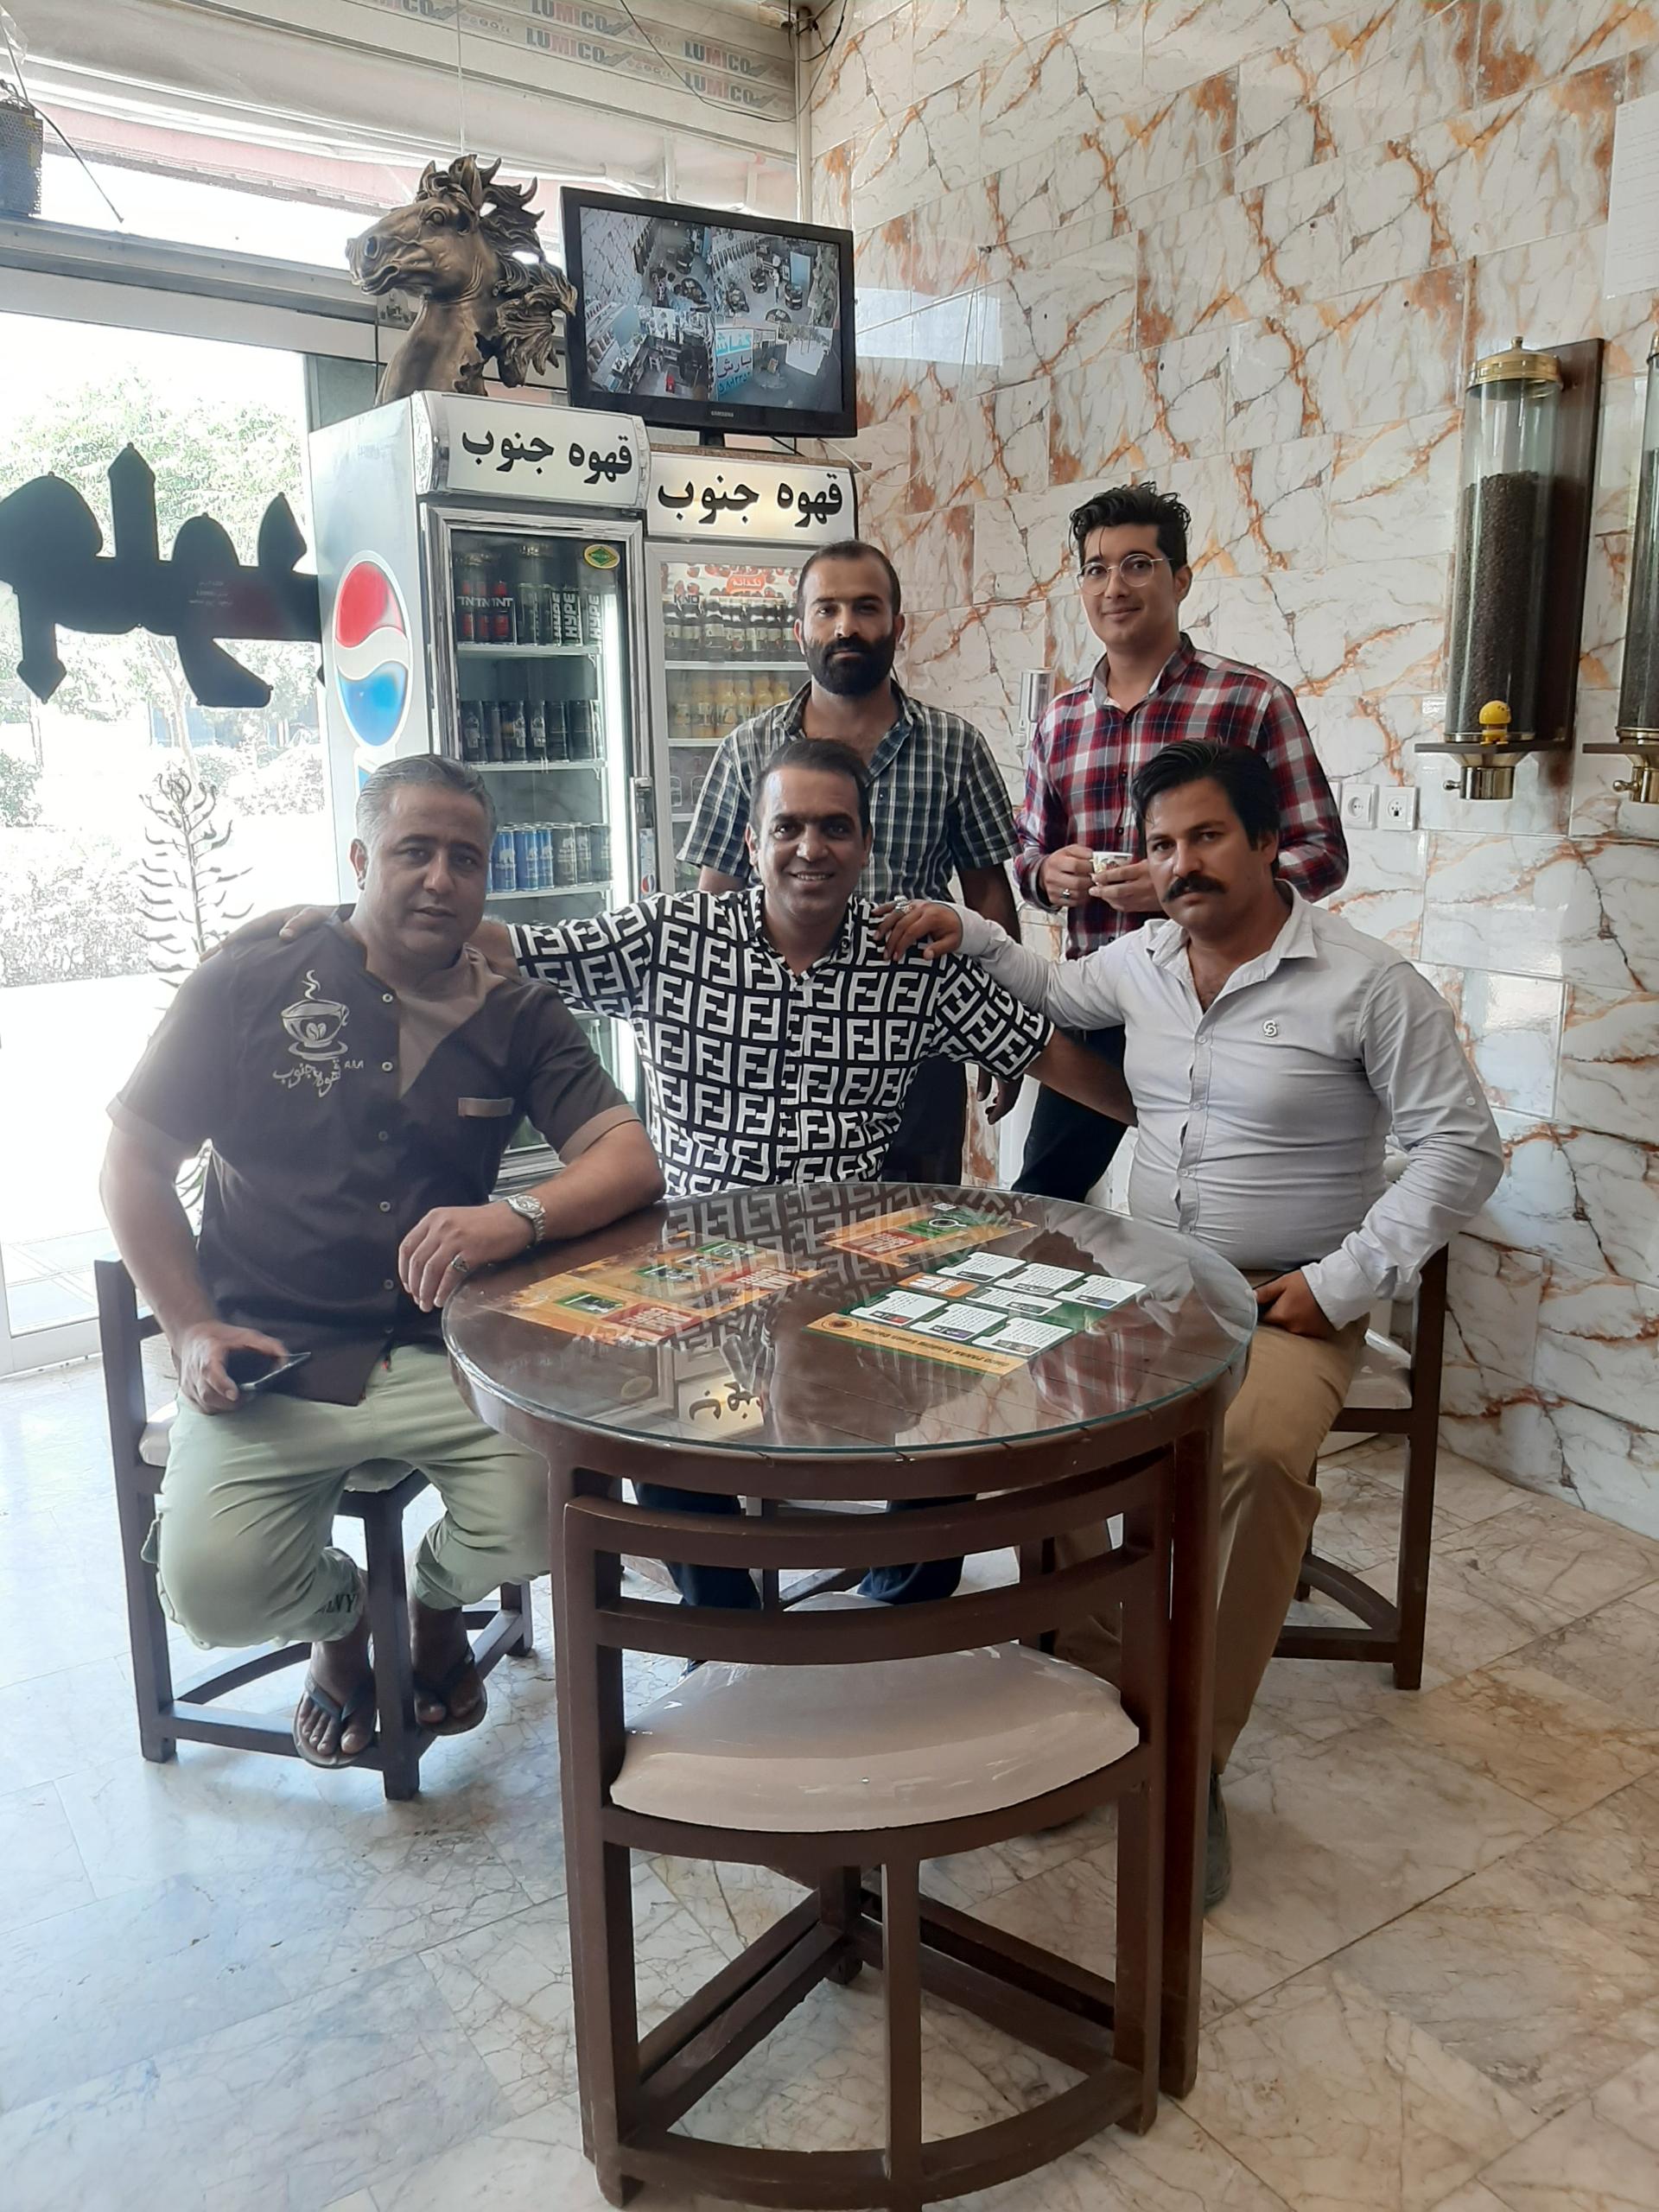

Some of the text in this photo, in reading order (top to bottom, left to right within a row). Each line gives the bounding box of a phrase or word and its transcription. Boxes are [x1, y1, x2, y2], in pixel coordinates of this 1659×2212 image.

[526, 27, 605, 64] LUMICO
[684, 41, 751, 73] LUMICO
[461, 429, 632, 485] قهوه جنوب
[658, 473, 842, 528] قهوه جنوب
[563, 593, 578, 637] HYPE
[588, 594, 603, 639] HYPE
[272, 1059, 342, 1097] قهوه جنوب
